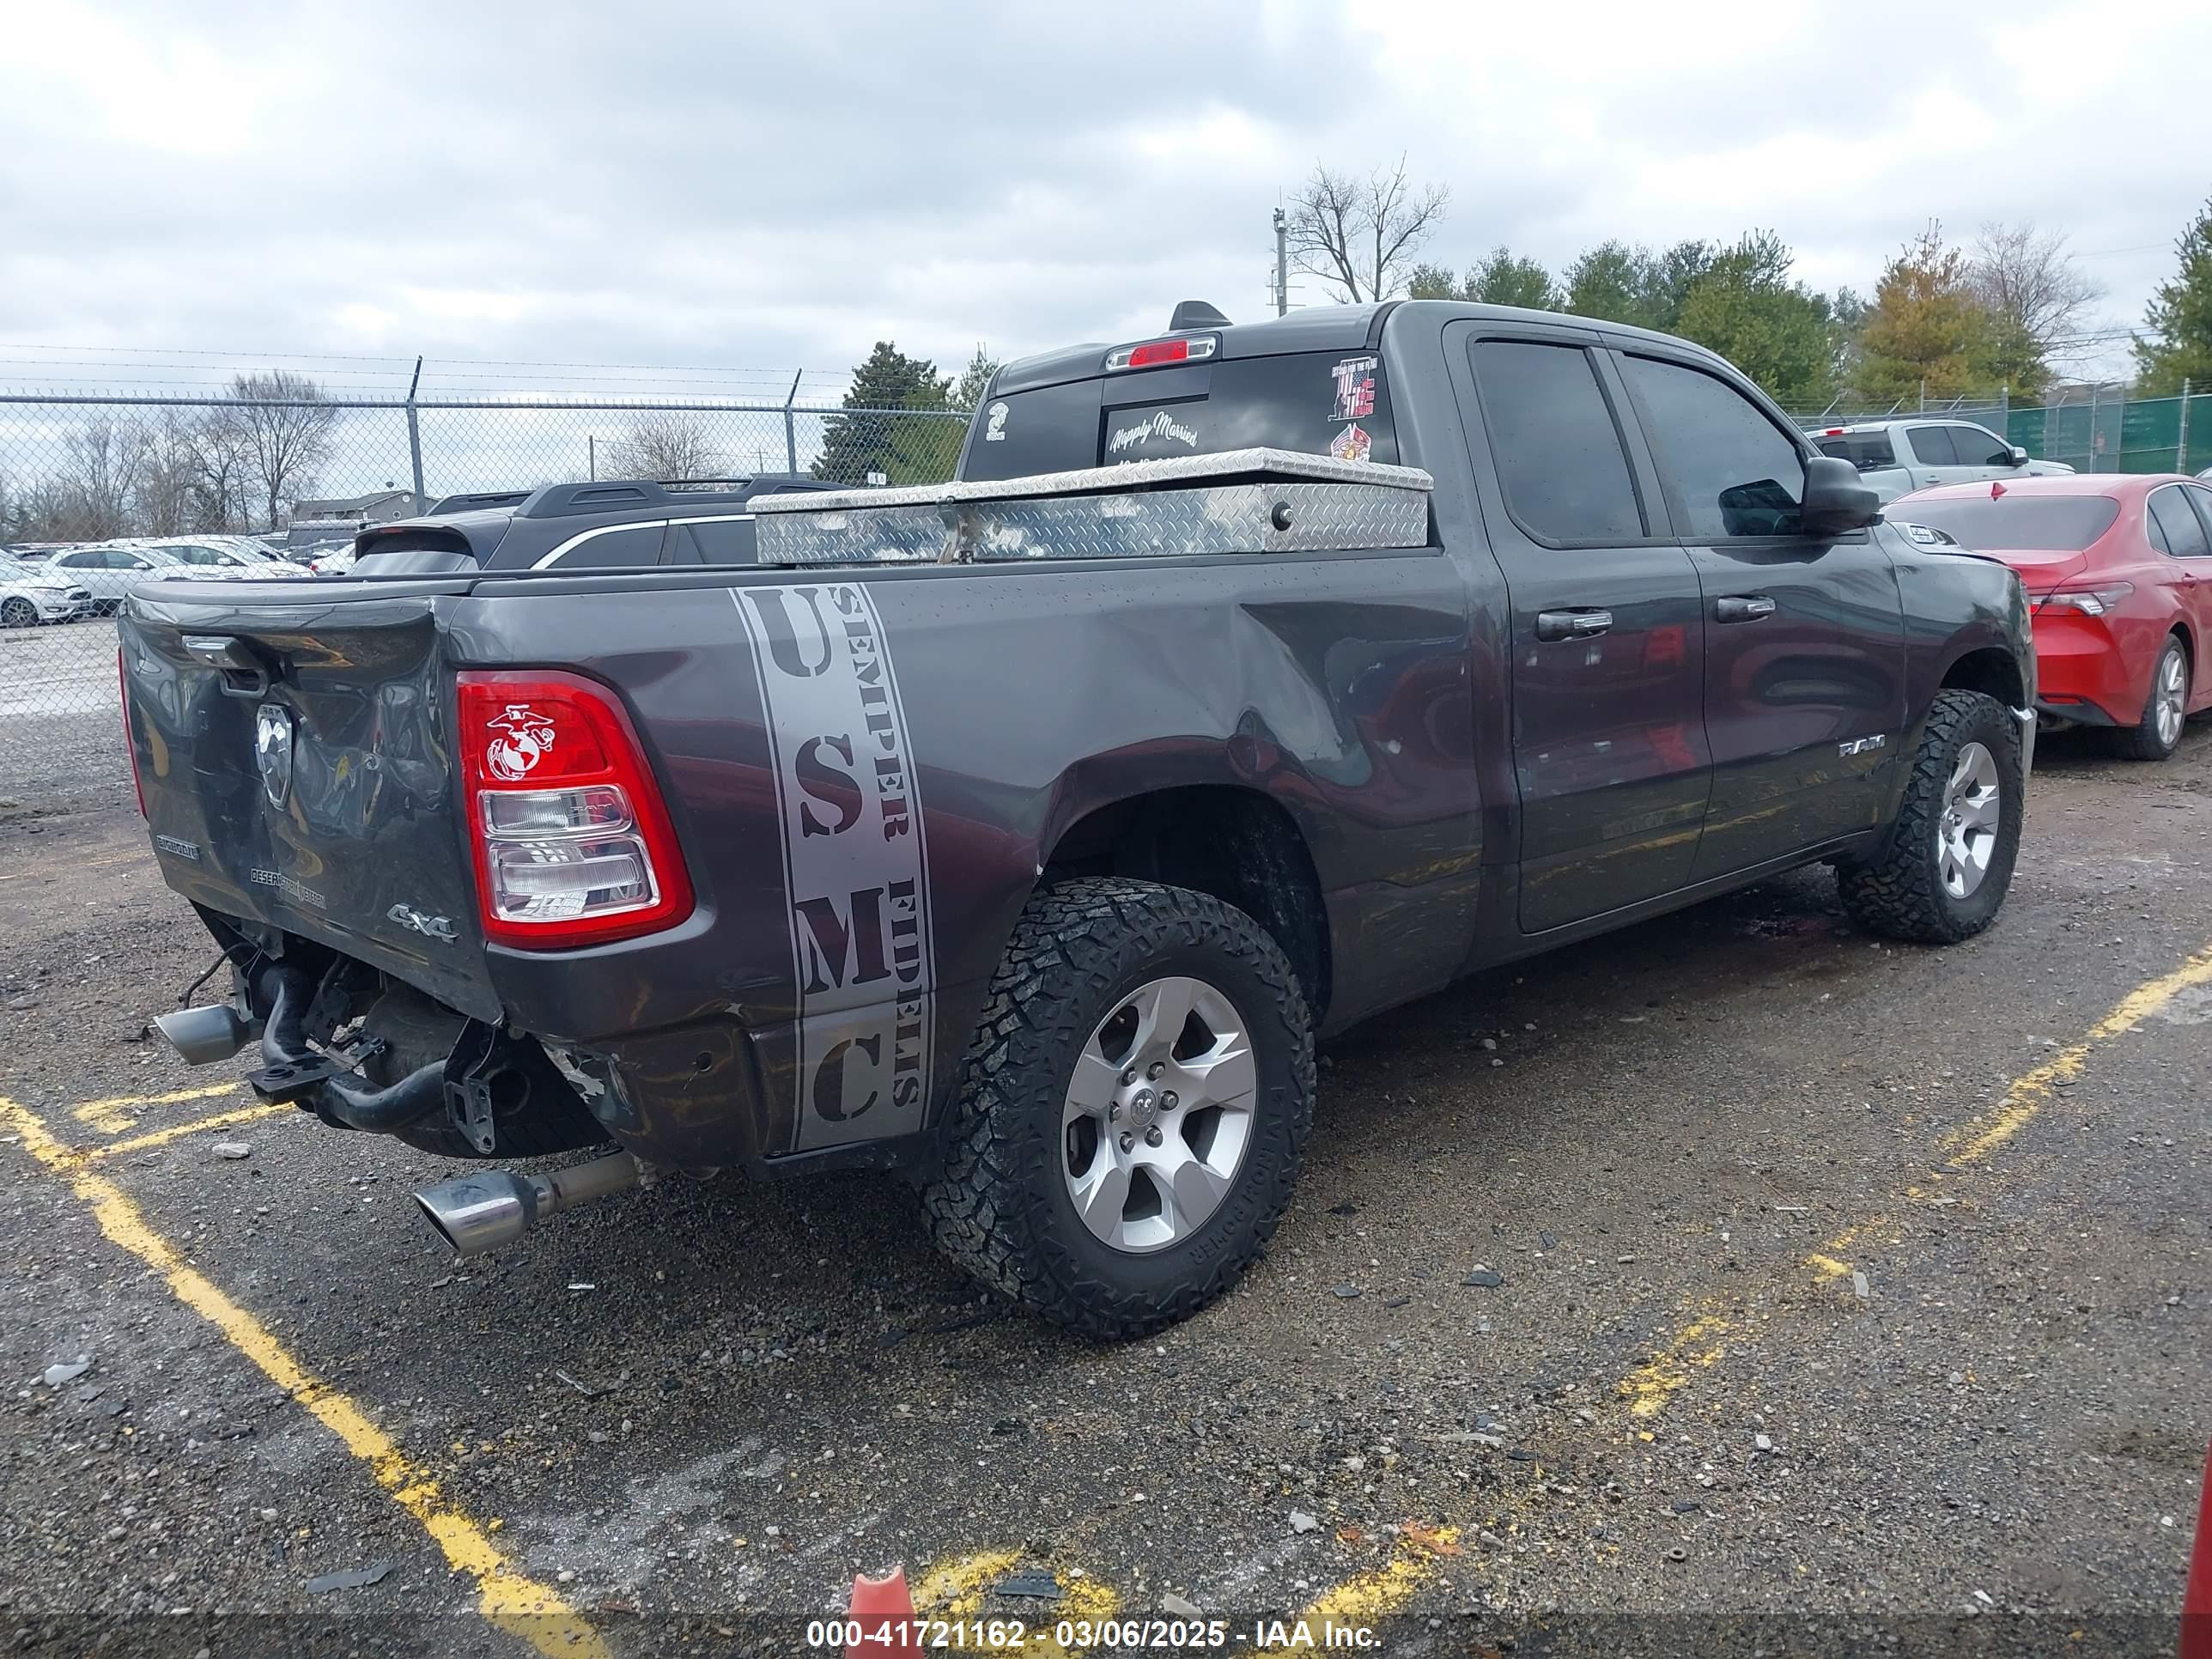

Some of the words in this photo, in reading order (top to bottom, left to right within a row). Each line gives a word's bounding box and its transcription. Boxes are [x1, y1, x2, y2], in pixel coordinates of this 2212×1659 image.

[1153, 411, 1198, 447] Married
[1838, 733, 1886, 757] RAM
[830, 586, 910, 844] SEMPER
[888, 876, 925, 1109] FIDELIS
